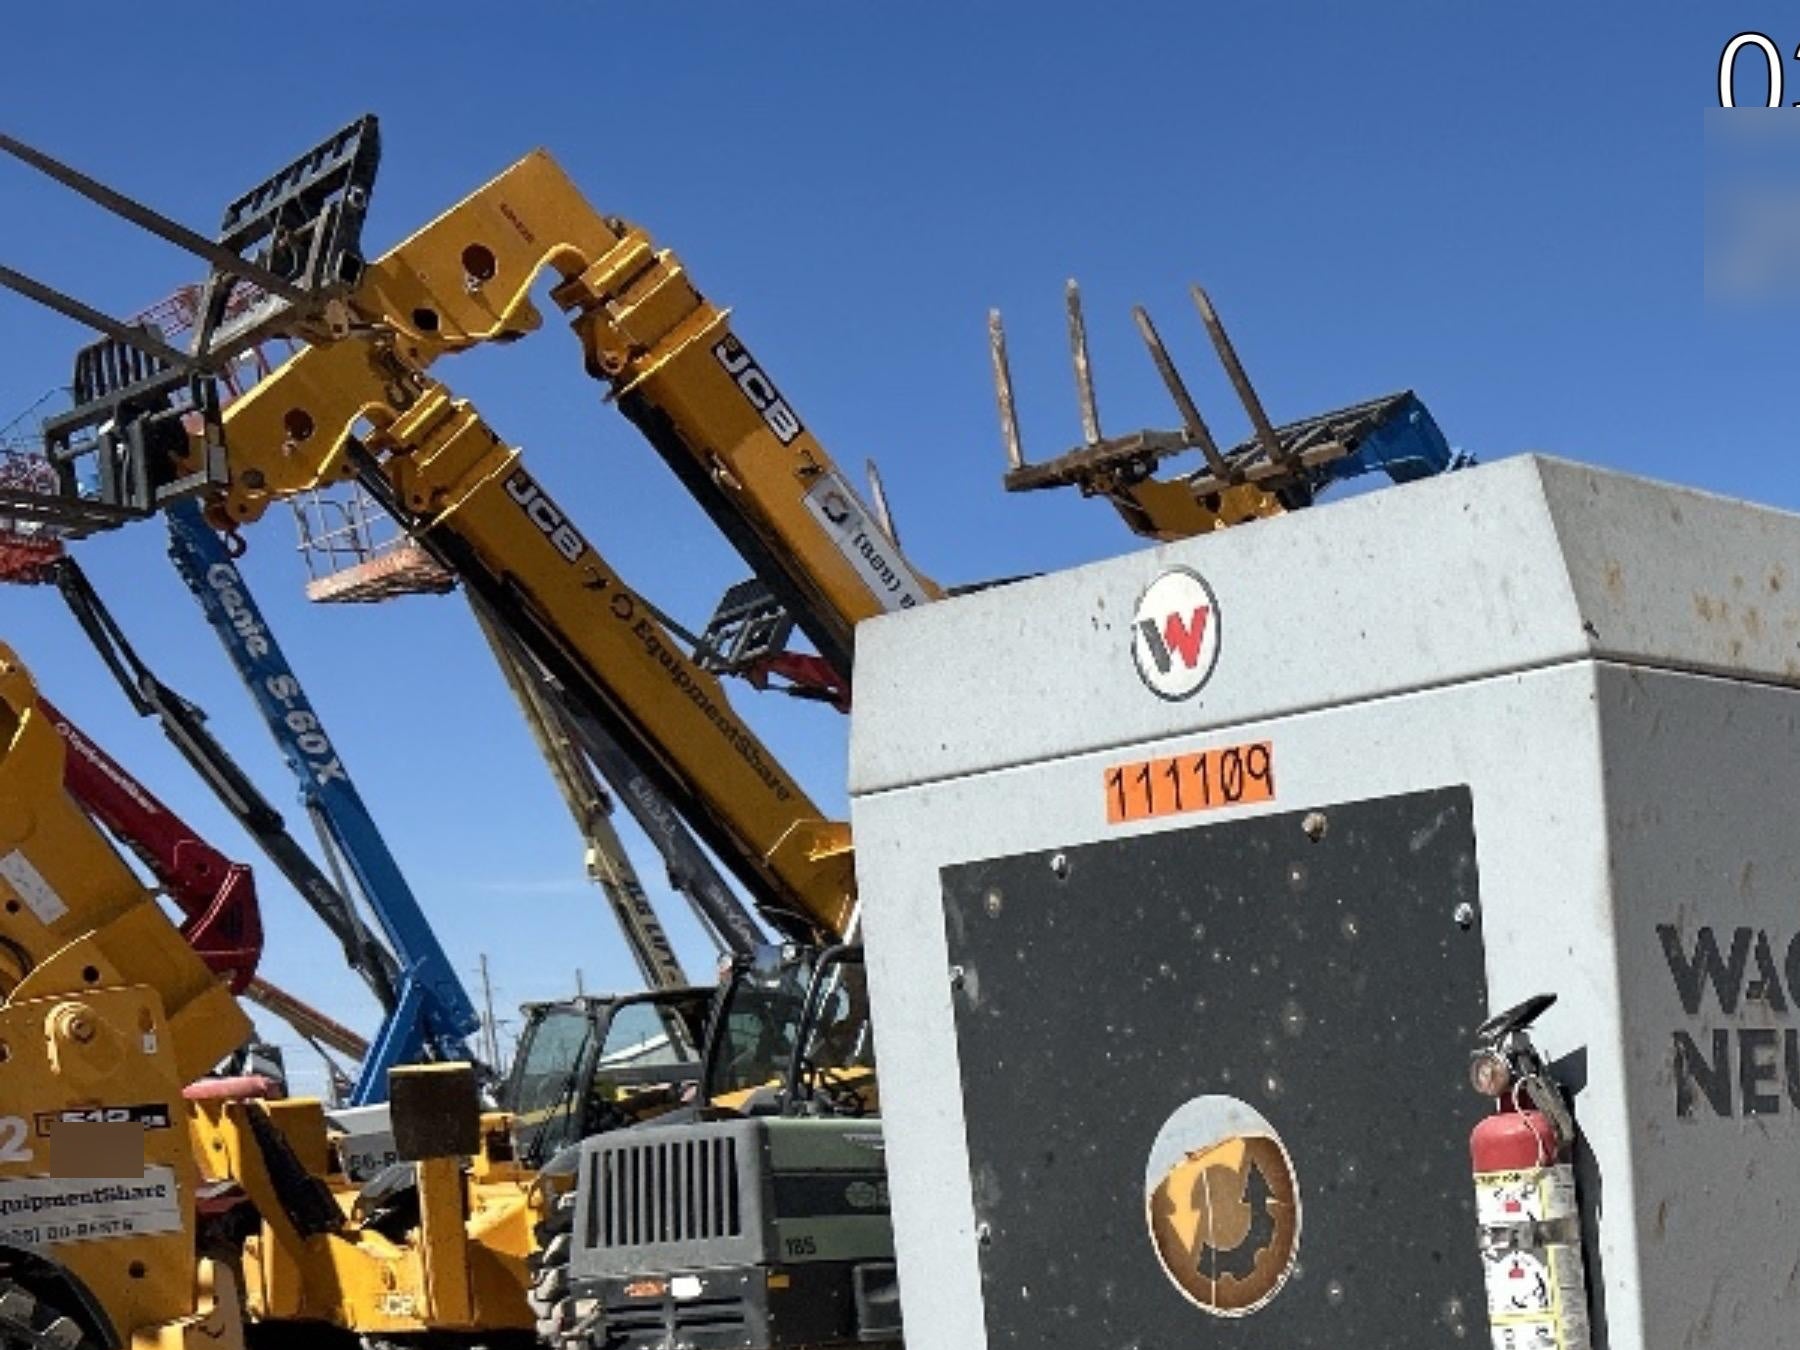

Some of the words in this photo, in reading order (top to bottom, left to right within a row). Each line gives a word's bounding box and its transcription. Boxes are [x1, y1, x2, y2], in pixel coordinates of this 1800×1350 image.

[714, 340, 801, 443] JCB
[505, 473, 586, 562] JCB
[206, 562, 270, 660] Genie
[1109, 744, 1274, 818] 111109
[0, 1184, 167, 1216] quipmentShare
